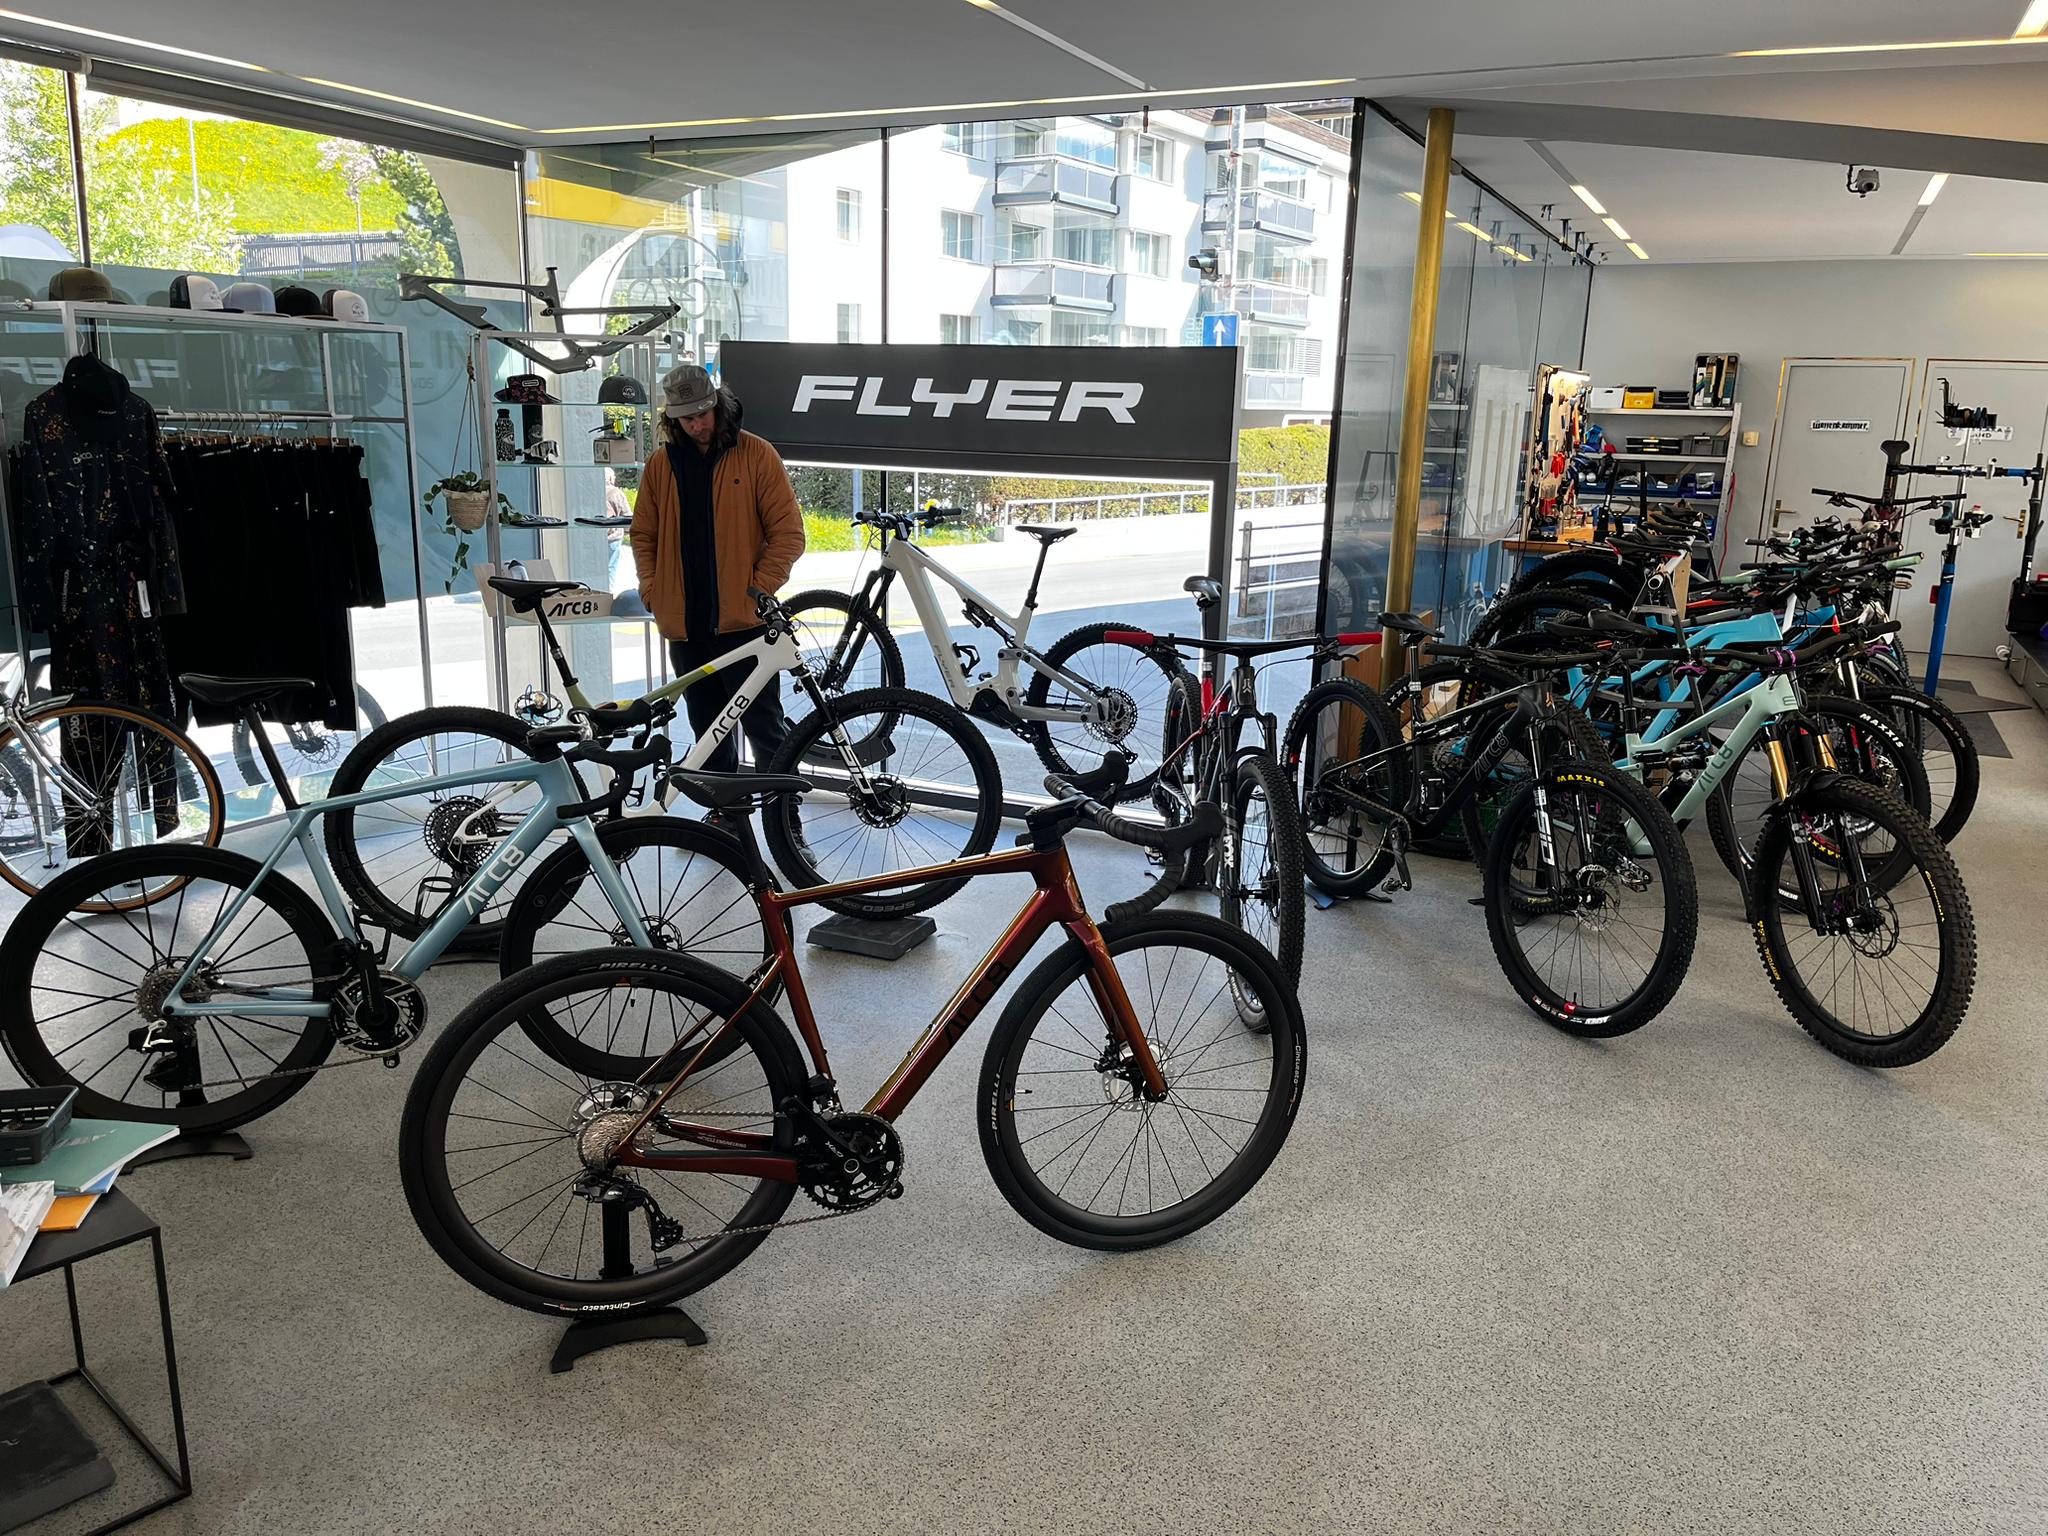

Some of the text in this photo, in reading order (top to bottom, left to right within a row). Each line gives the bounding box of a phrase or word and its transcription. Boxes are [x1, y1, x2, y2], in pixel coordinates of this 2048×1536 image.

[792, 375, 1143, 423] FLYER
[1860, 713, 1904, 748] MAXXIS
[1557, 774, 1605, 787] MAXXIS
[1223, 834, 1234, 868] FOX
[862, 900, 915, 912] SPEED
[599, 962, 667, 971] PIRELLI
[991, 1073, 1000, 1131] PIRELLI
